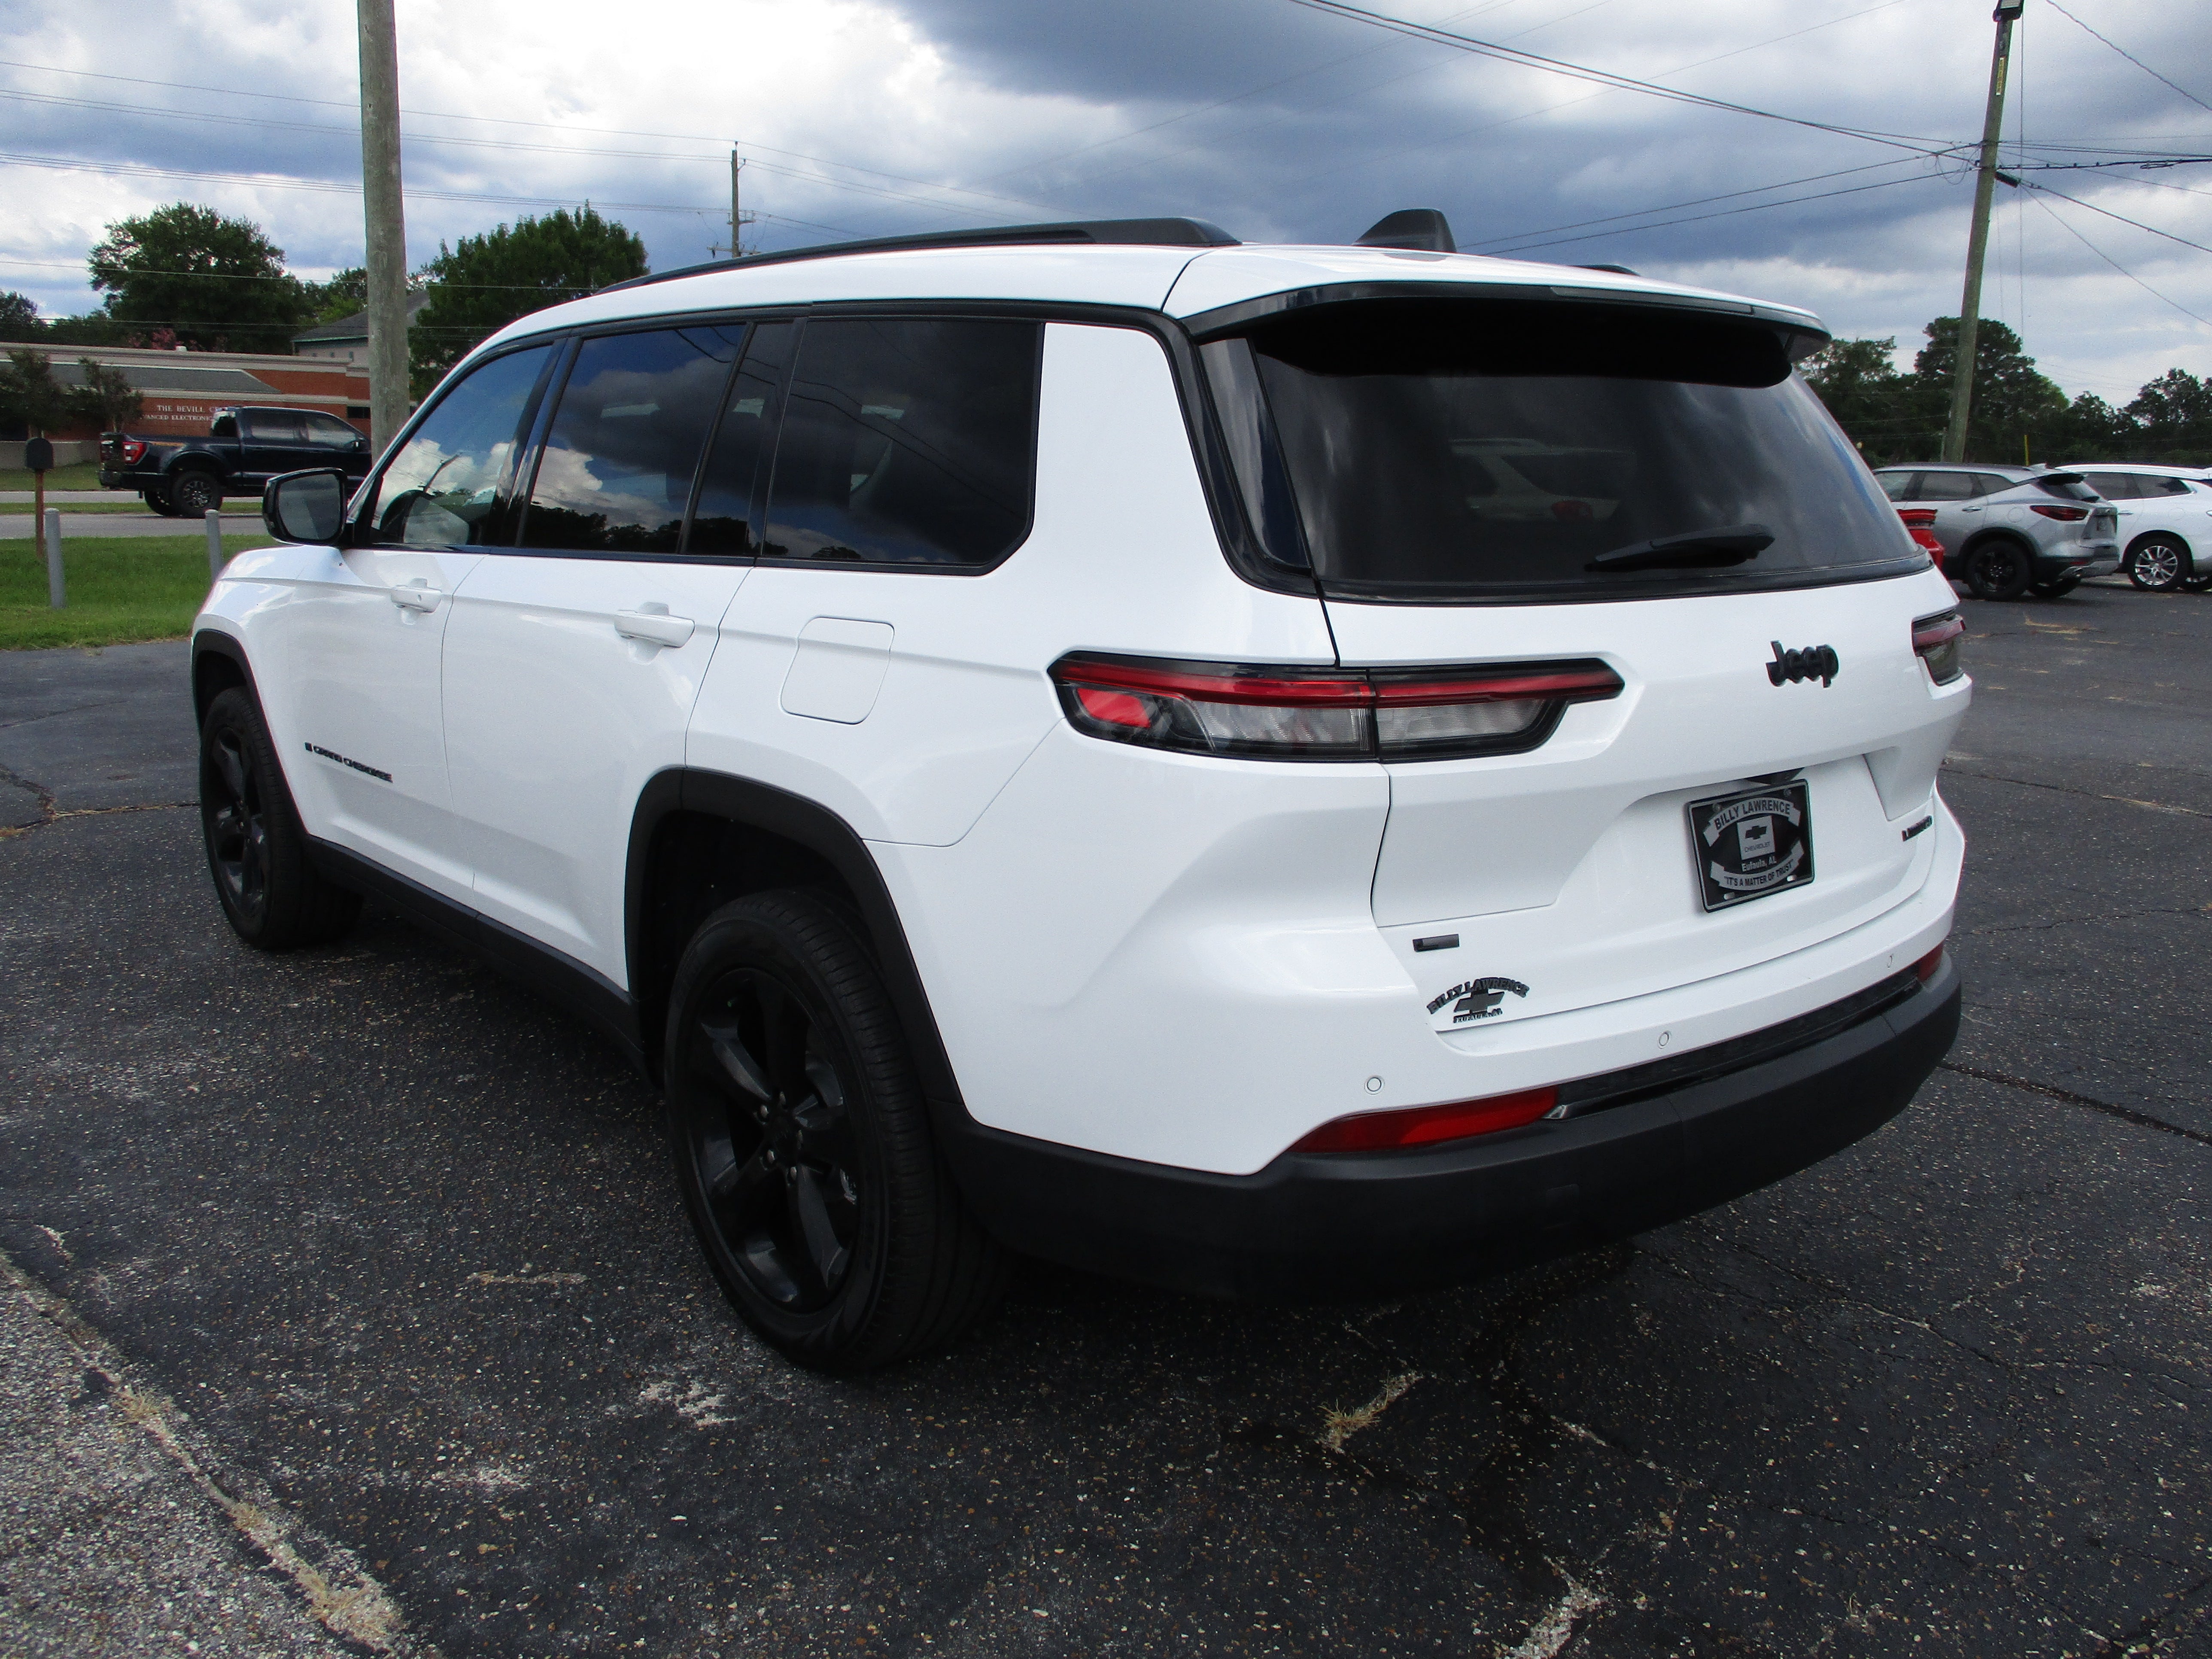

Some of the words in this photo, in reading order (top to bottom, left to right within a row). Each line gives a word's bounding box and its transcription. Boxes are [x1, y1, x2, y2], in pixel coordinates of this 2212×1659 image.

[1714, 806, 1739, 830] BILLY
[1742, 799, 1790, 815] LAWRENCE
[1744, 841, 1771, 852] CHEVROLET
[1768, 856, 1777, 865] AL
[1744, 875, 1767, 886] MATTER
[1768, 872, 1775, 881] OF
[1426, 984, 1463, 1015] BILLY
[1464, 977, 1530, 998] LAWRENCE
